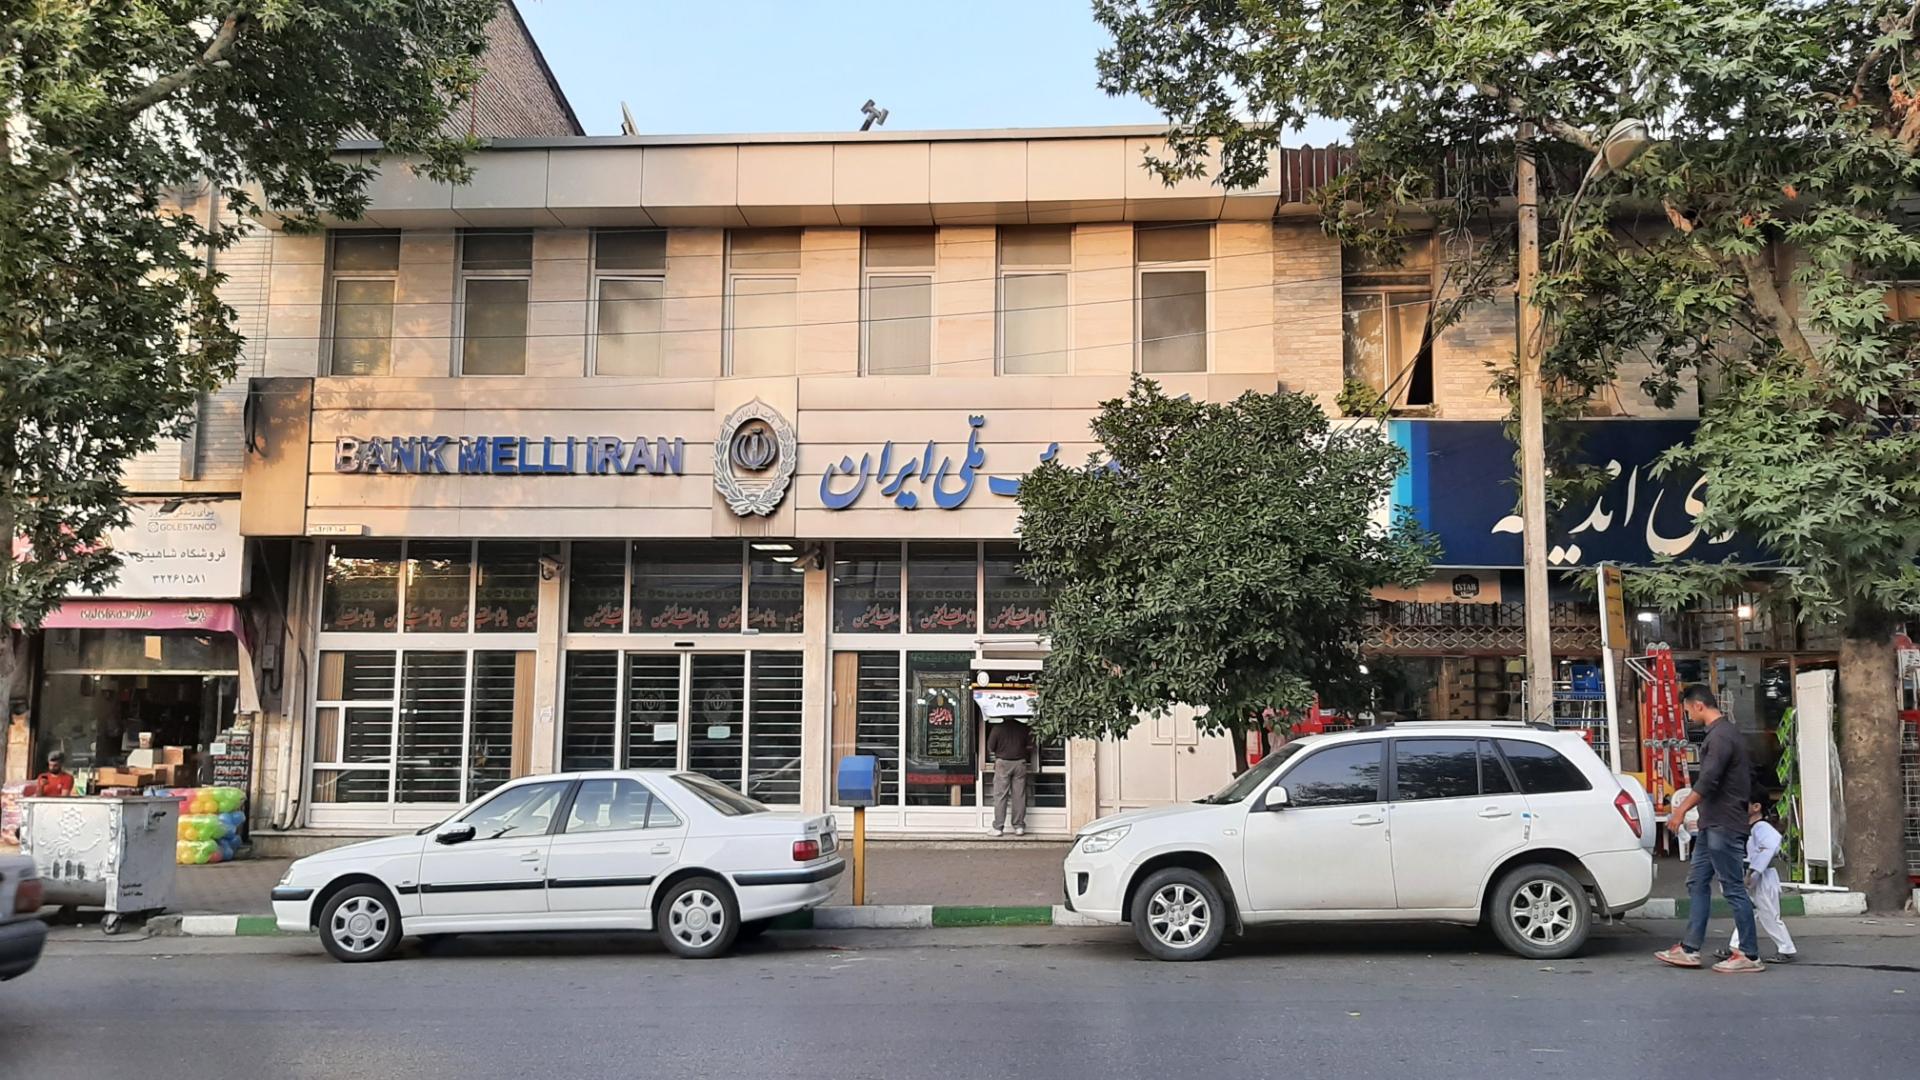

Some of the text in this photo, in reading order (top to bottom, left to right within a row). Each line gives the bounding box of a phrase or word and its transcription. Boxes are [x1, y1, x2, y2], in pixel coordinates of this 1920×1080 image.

[334, 435, 686, 477] BANK MELLI IRAN
[820, 439, 935, 510] ایران
[180, 547, 226, 562] فروشگاه
[152, 574, 207, 584] ۳۲۲۶۱۵۸۱
